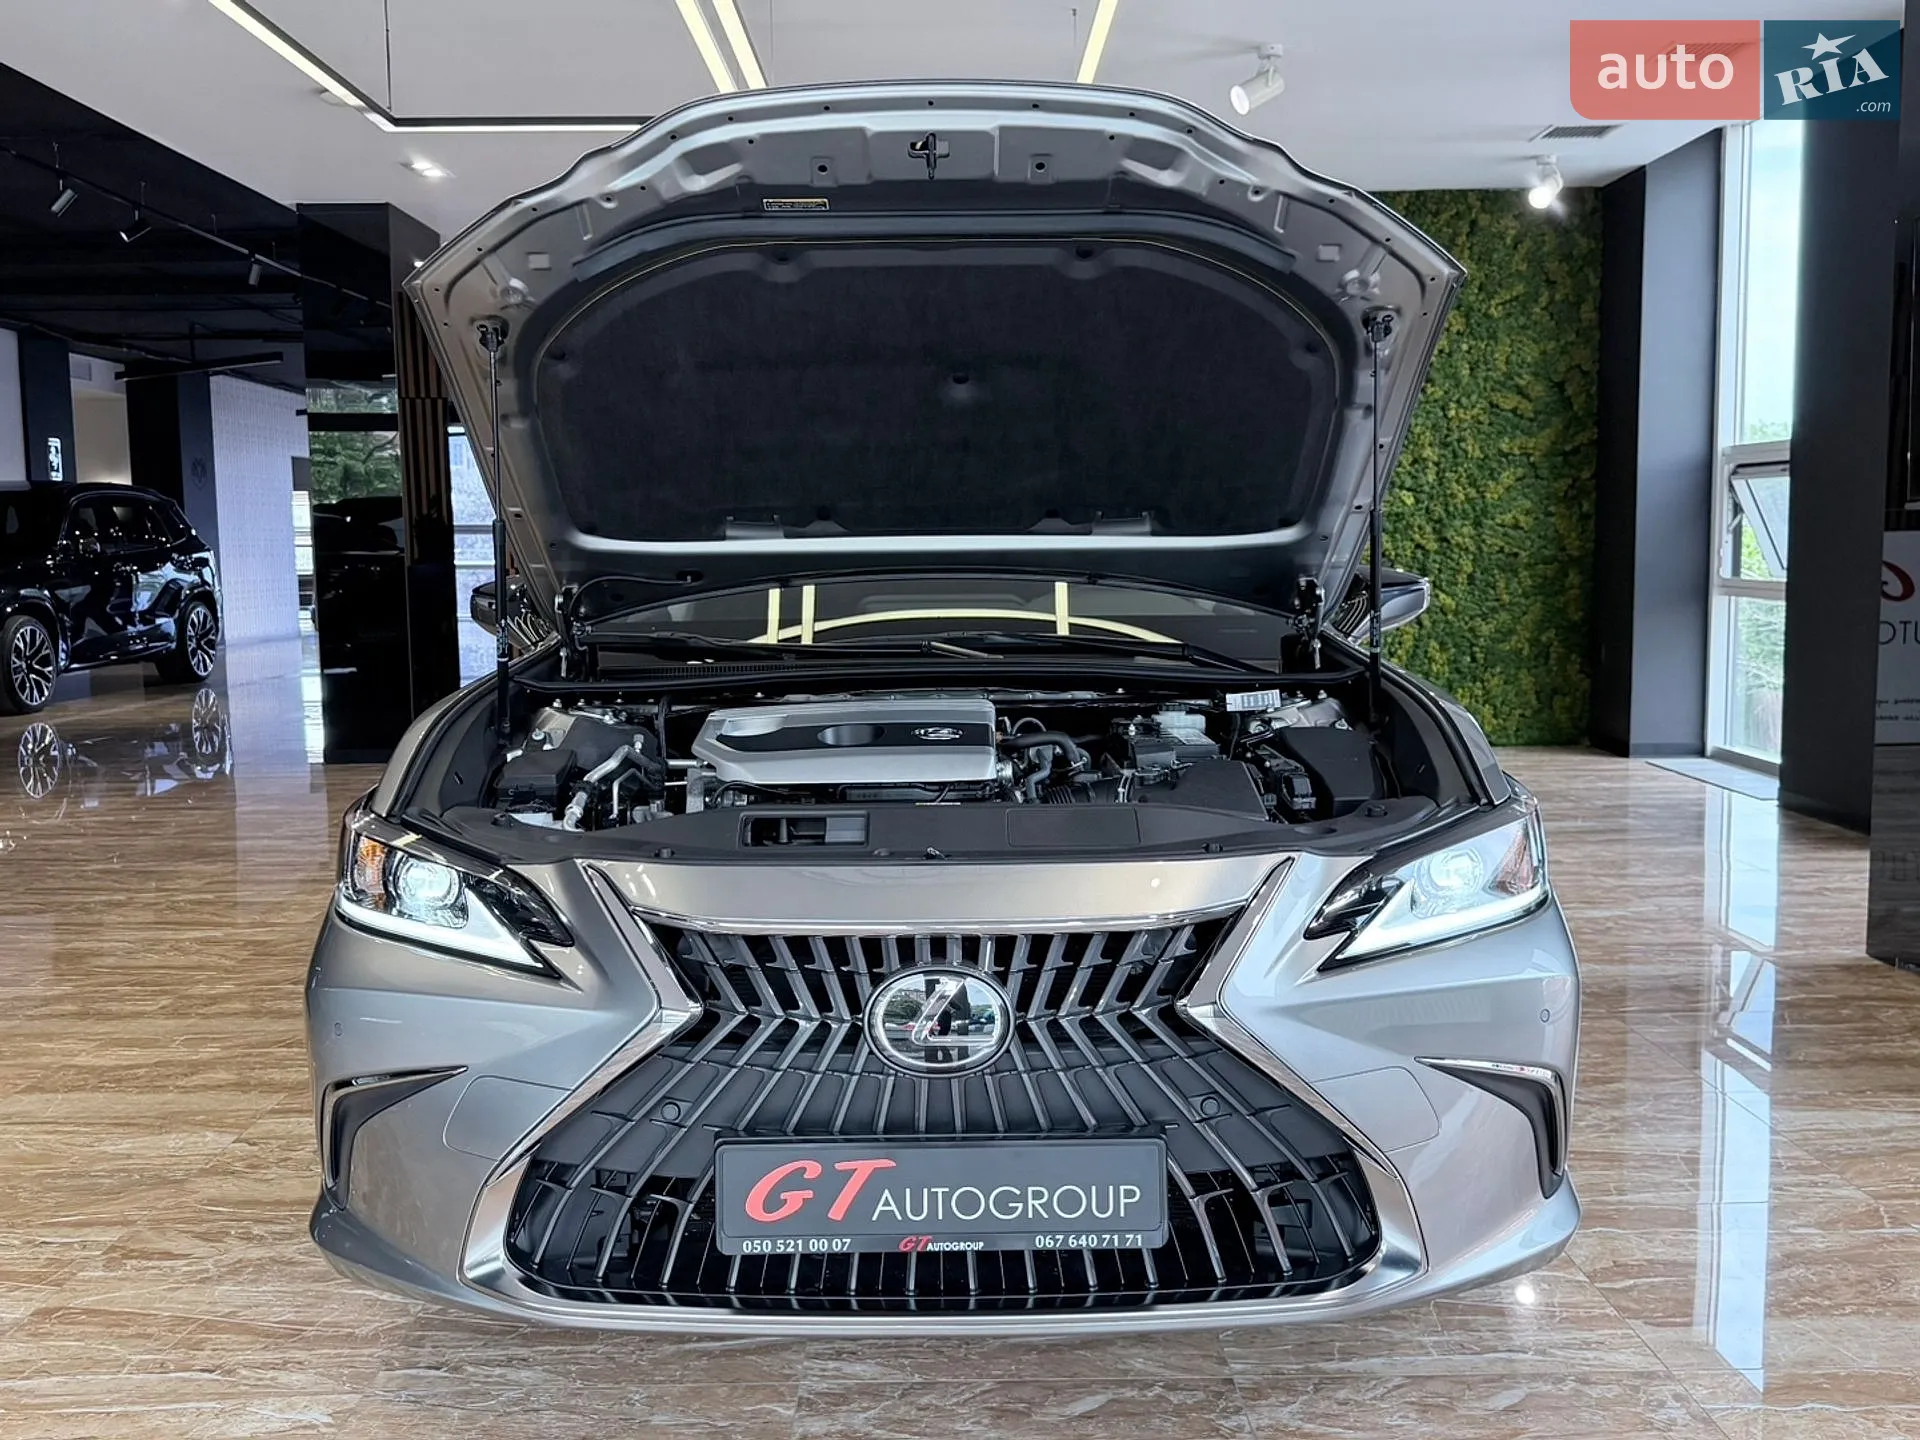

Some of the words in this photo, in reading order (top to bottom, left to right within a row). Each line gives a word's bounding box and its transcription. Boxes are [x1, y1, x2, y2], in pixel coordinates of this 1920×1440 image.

[744, 1158, 897, 1223] GT
[872, 1184, 1142, 1222] AUTOGROUP
[742, 1239, 772, 1253] 050
[775, 1239, 803, 1253] 521
[808, 1239, 829, 1252] 00
[832, 1238, 852, 1252] 07
[898, 1236, 932, 1252] GT
[926, 1240, 984, 1252] AUTOGROUP
[1035, 1234, 1065, 1248] 067
[1069, 1234, 1097, 1248] 640
[1101, 1234, 1122, 1247] 71
[1126, 1234, 1143, 1247] 71
